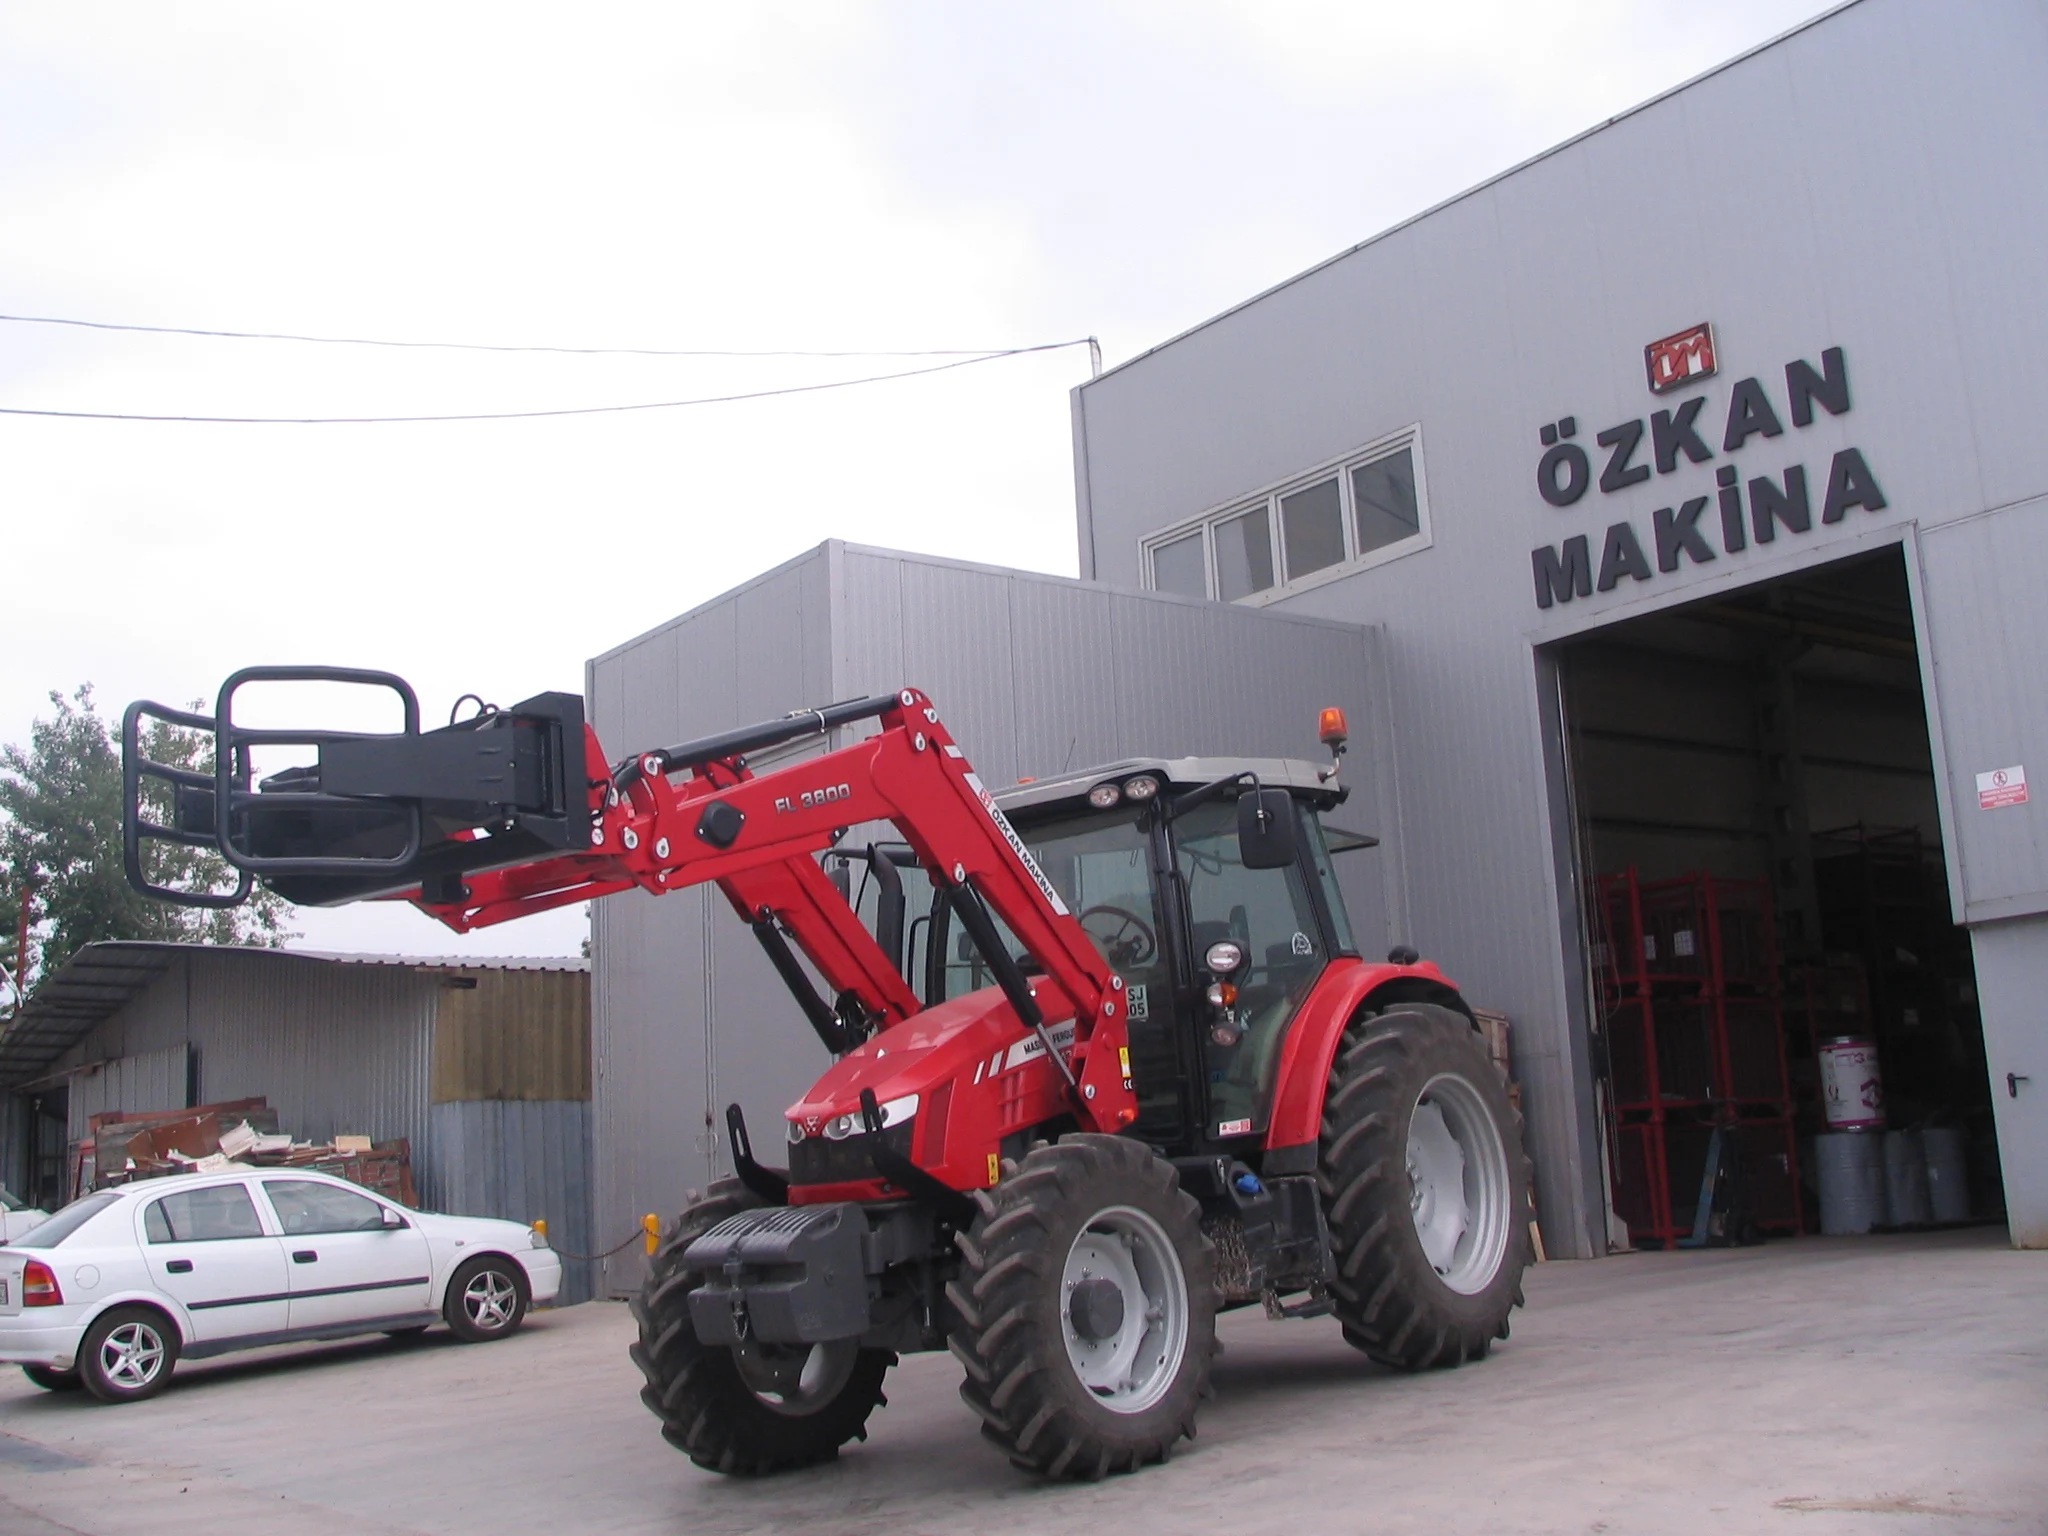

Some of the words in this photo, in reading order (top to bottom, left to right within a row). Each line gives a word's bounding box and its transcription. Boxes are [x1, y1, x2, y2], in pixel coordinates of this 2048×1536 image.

[1537, 346, 1850, 507] ÖZKAN
[1531, 447, 1887, 609] MAKİNA
[774, 796, 797, 815] FL
[800, 783, 851, 808] 3800
[1129, 1002, 1146, 1017] 05
